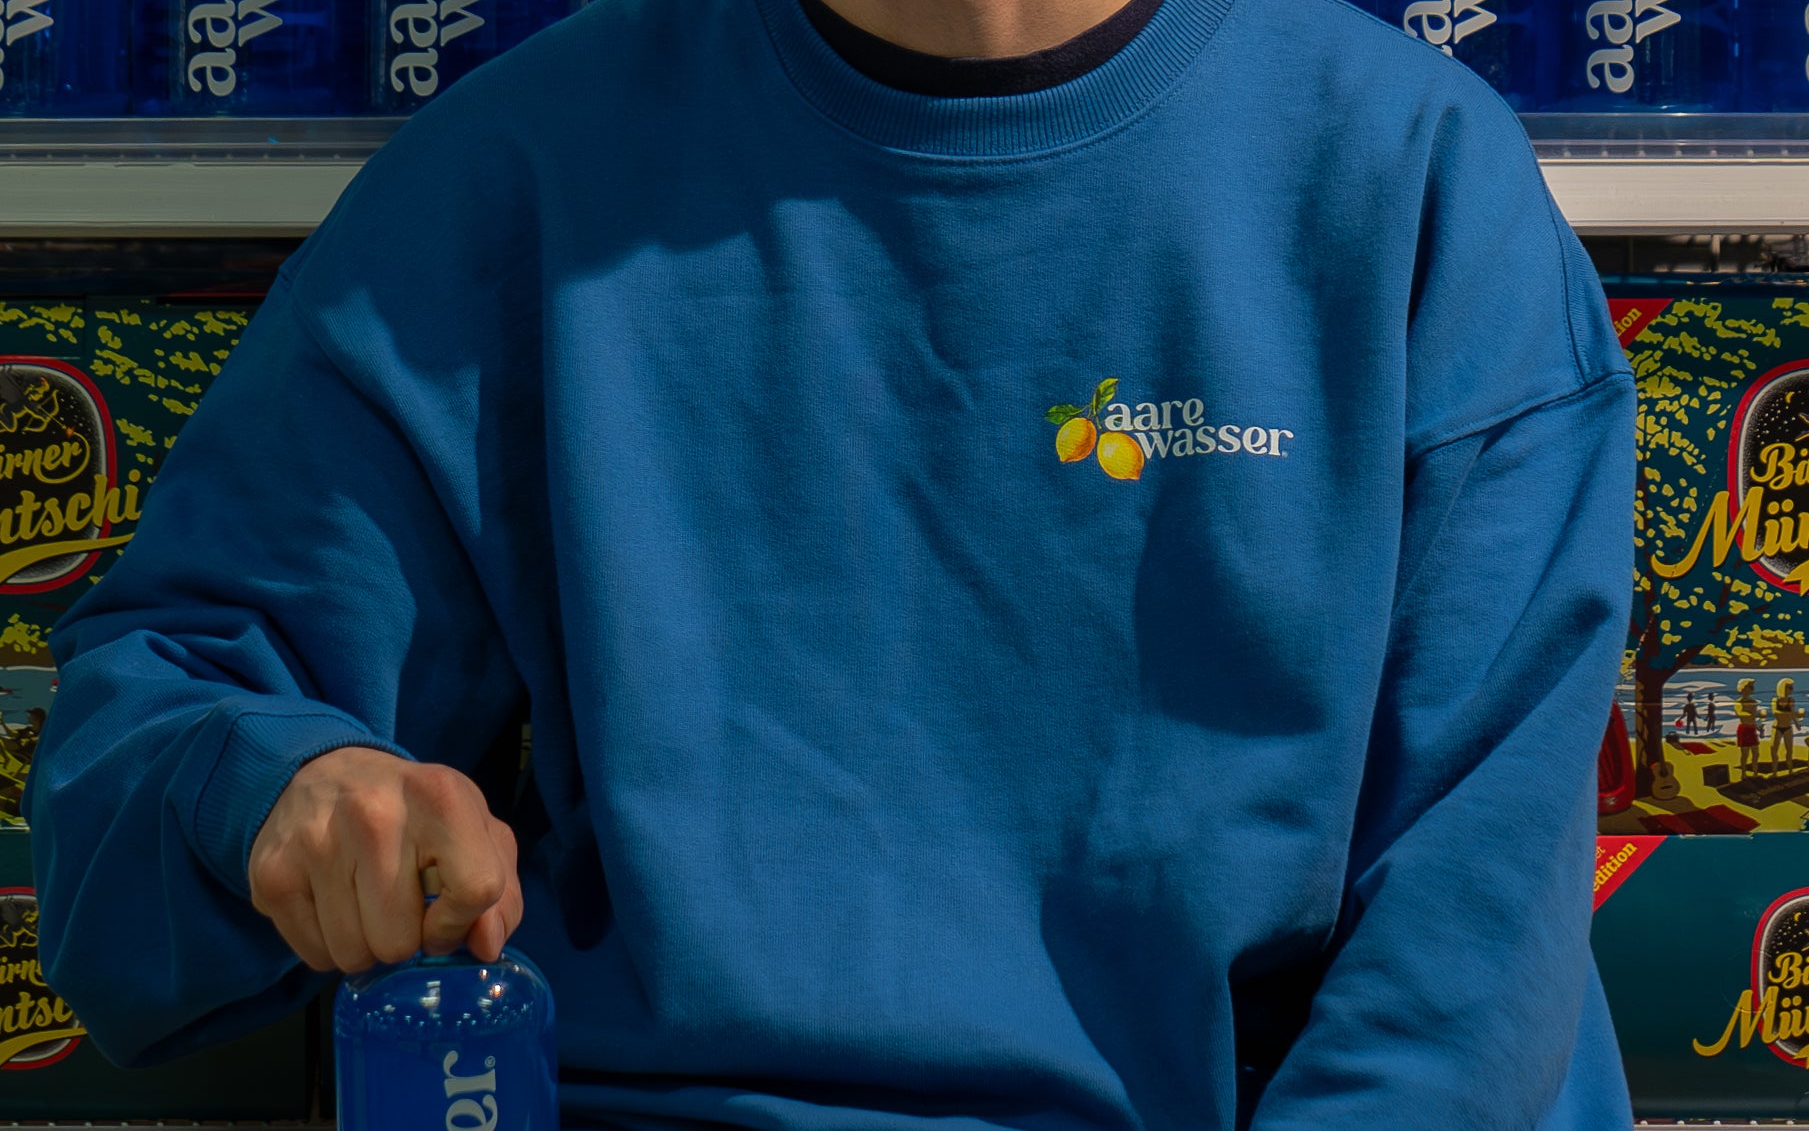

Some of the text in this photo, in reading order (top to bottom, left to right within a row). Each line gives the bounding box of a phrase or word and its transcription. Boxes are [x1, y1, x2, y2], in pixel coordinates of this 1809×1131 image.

[1613, 307, 1643, 336] ion
[1104, 397, 1205, 431] aare
[1134, 424, 1294, 459] wasser
[1692, 986, 1809, 1057] Mü
